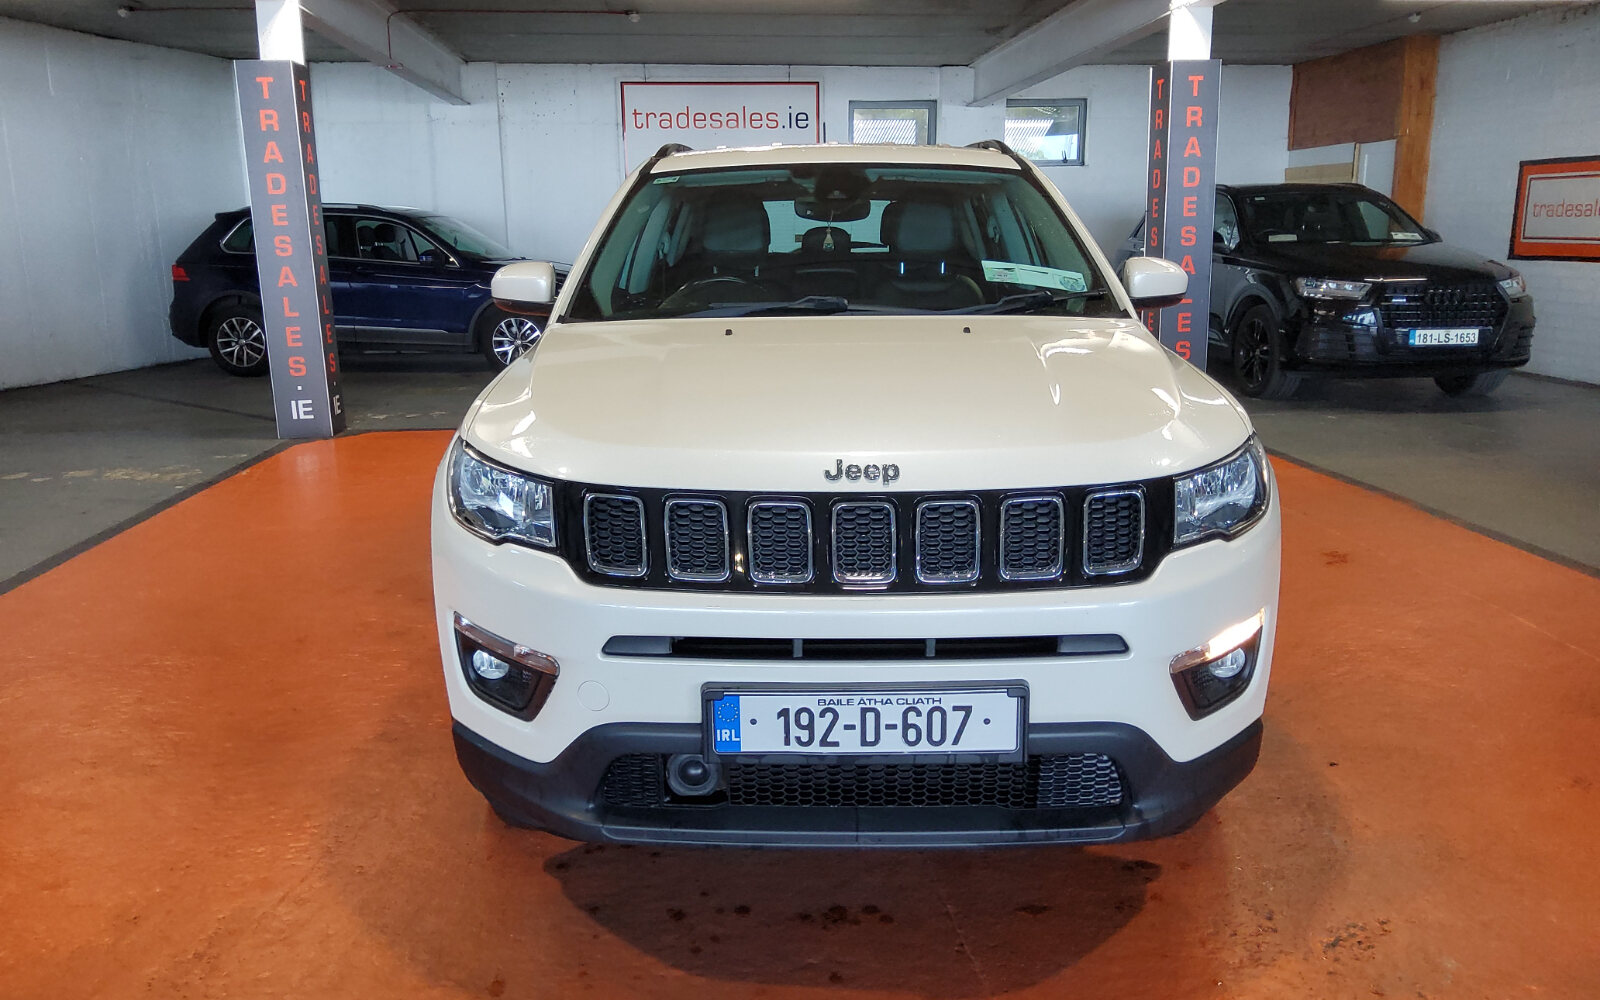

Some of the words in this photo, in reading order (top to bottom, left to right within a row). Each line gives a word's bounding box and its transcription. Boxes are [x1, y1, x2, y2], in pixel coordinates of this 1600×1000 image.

[632, 105, 809, 129] tradesales.ie
[1175, 75, 1204, 361] TRADESAES
[1533, 198, 1600, 218] tradesal
[1417, 332, 1476, 344] 181-LS-1653
[824, 459, 900, 486] Jeep
[818, 698, 855, 706] BAILE
[896, 697, 942, 706] CLIATH
[716, 729, 740, 742] IRL
[776, 705, 973, 747] 192-D-607
